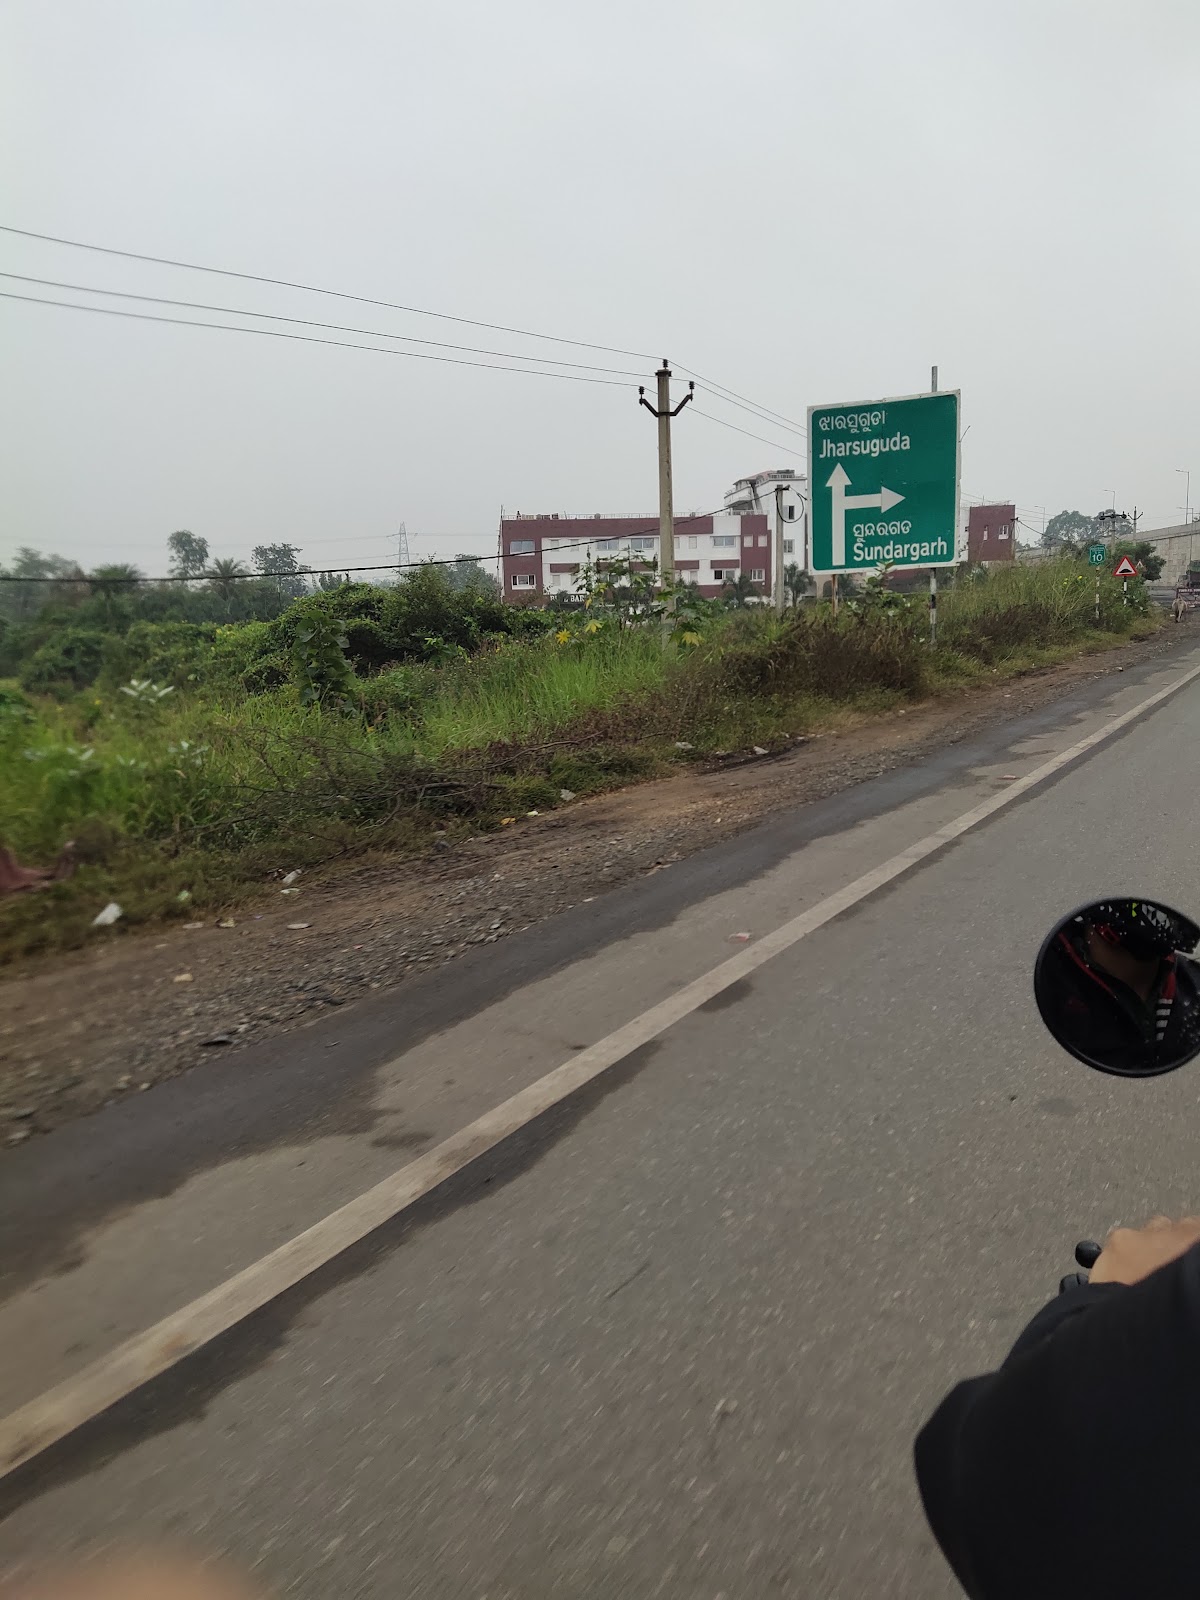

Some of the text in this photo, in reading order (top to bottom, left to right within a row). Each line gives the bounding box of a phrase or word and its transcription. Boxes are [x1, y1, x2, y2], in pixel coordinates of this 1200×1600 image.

[819, 432, 910, 458] Jharsuguda
[853, 537, 947, 562] Sundargarh
[1092, 554, 1103, 562] 10
